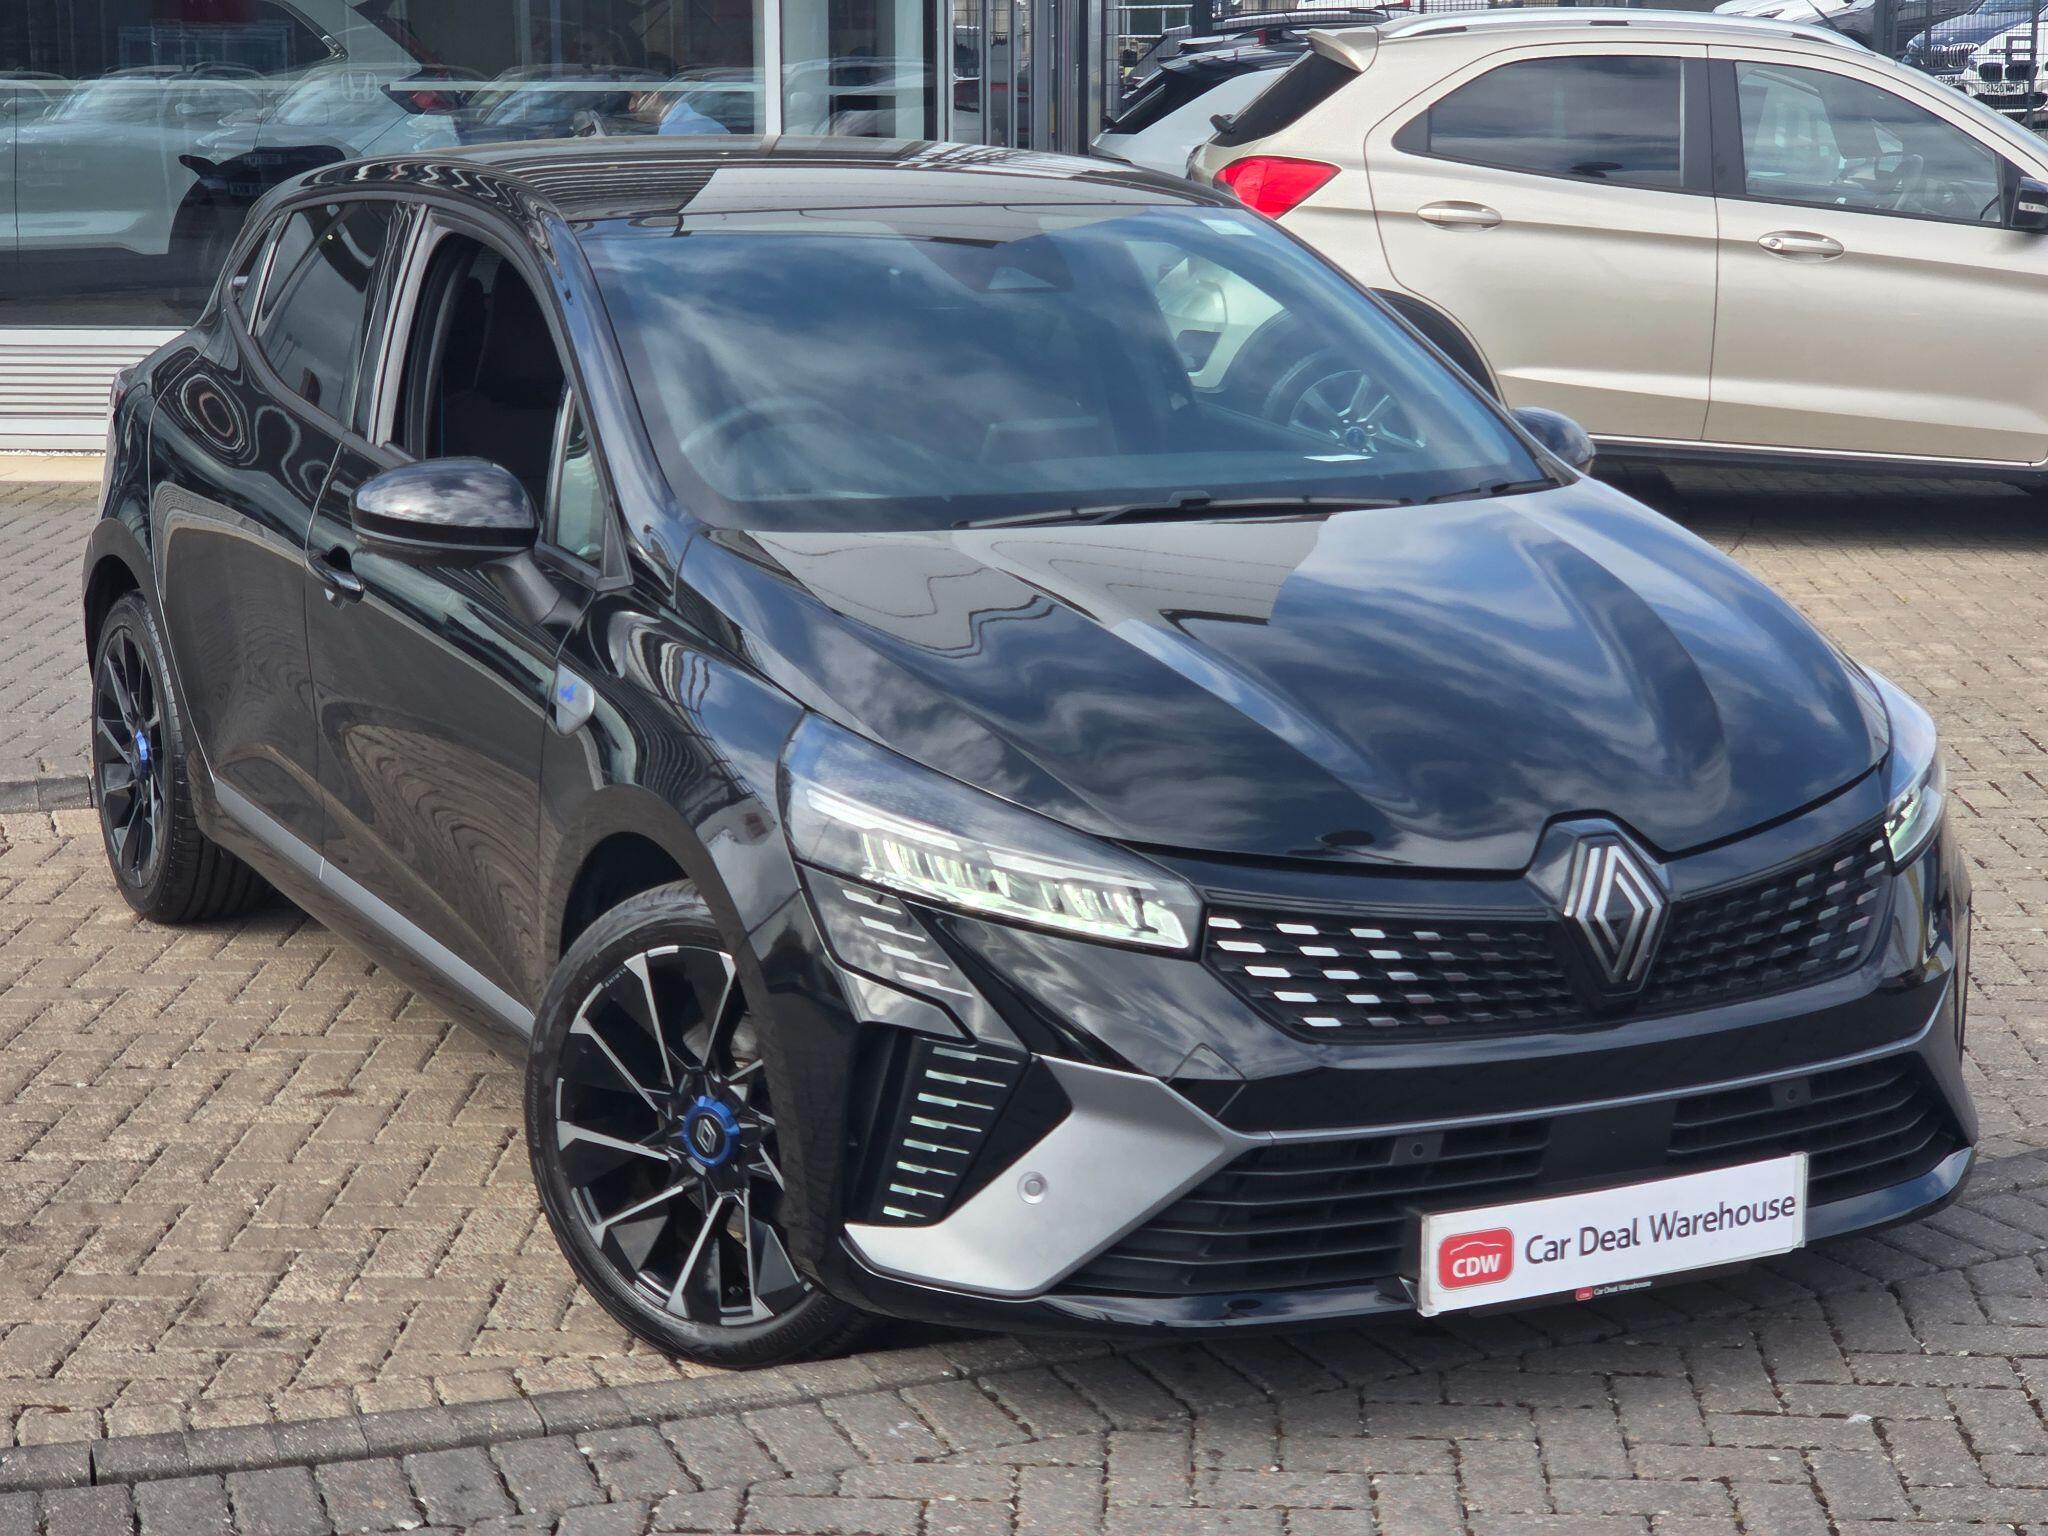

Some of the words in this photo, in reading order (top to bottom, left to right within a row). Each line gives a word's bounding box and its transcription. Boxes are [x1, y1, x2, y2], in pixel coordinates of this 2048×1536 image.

[1525, 1234, 1571, 1264] Car
[1579, 1217, 1641, 1256] Deal
[1648, 1196, 1796, 1242] Warehouse
[1452, 1253, 1502, 1278] CDW
